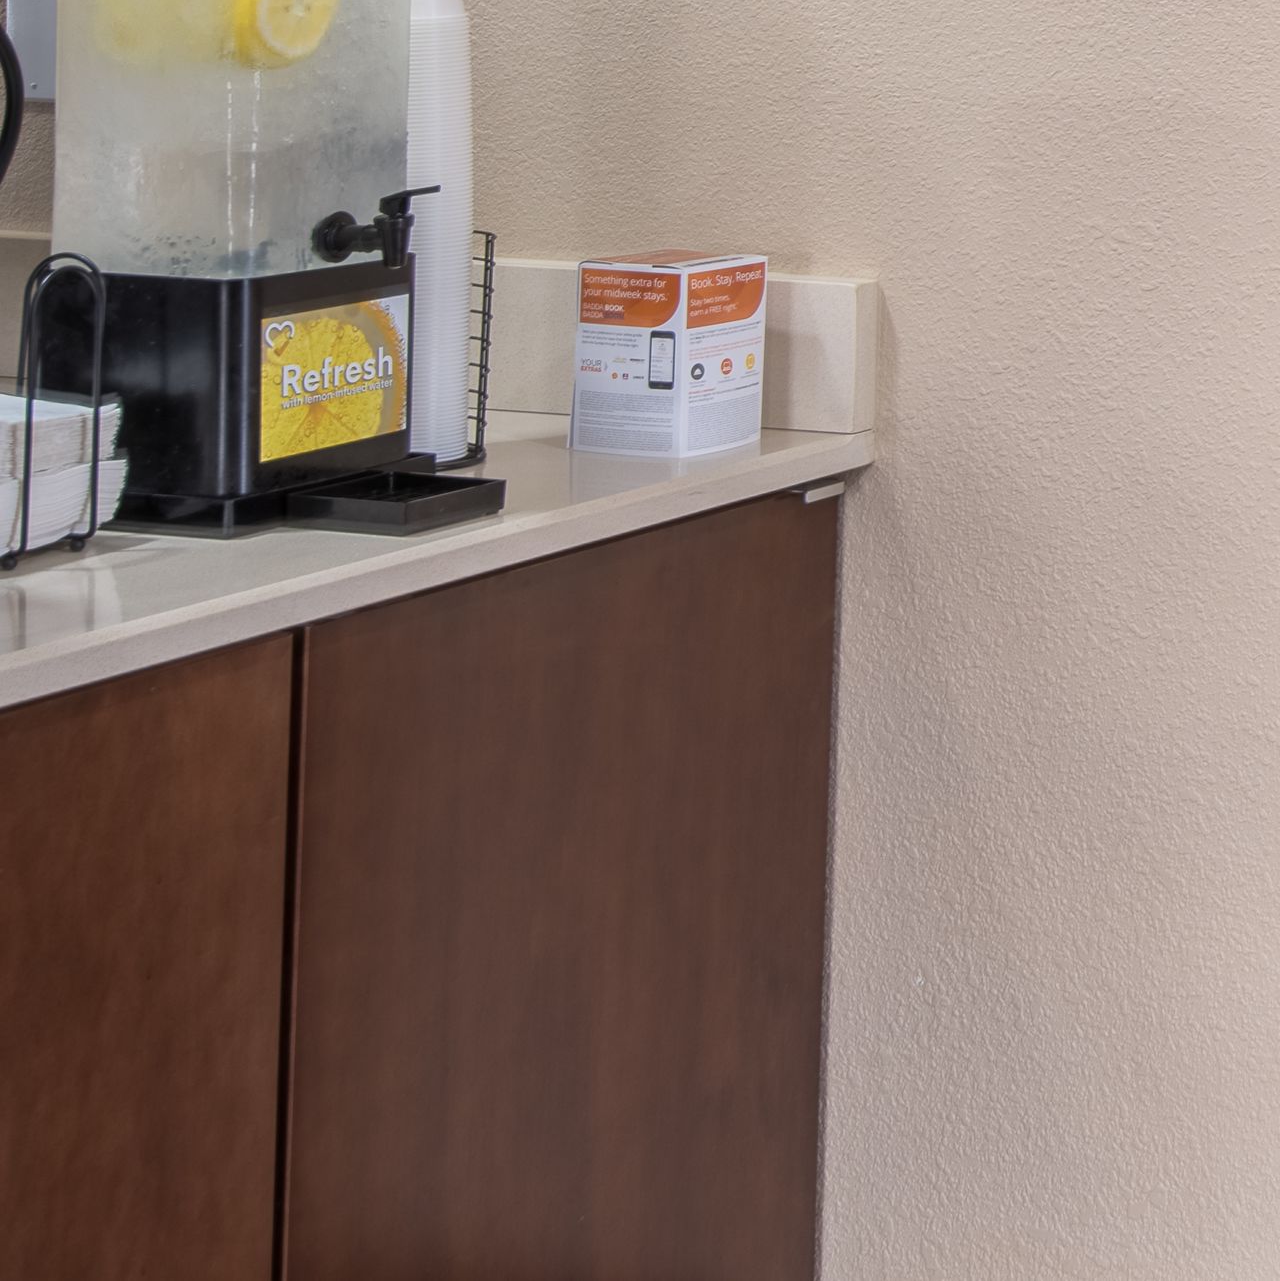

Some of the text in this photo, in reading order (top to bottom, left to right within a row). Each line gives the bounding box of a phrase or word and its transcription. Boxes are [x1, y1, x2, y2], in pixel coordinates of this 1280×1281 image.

[583, 273, 667, 288] Something extra for
[691, 269, 763, 290] Book. Stay. Repeat.
[583, 288, 668, 302] your midweek stays.
[690, 298, 703, 307] Stay
[709, 305, 722, 313] FREE
[581, 358, 602, 367] YOUR
[282, 346, 393, 398] Refresh
[281, 378, 393, 409] with lemon-infused water
